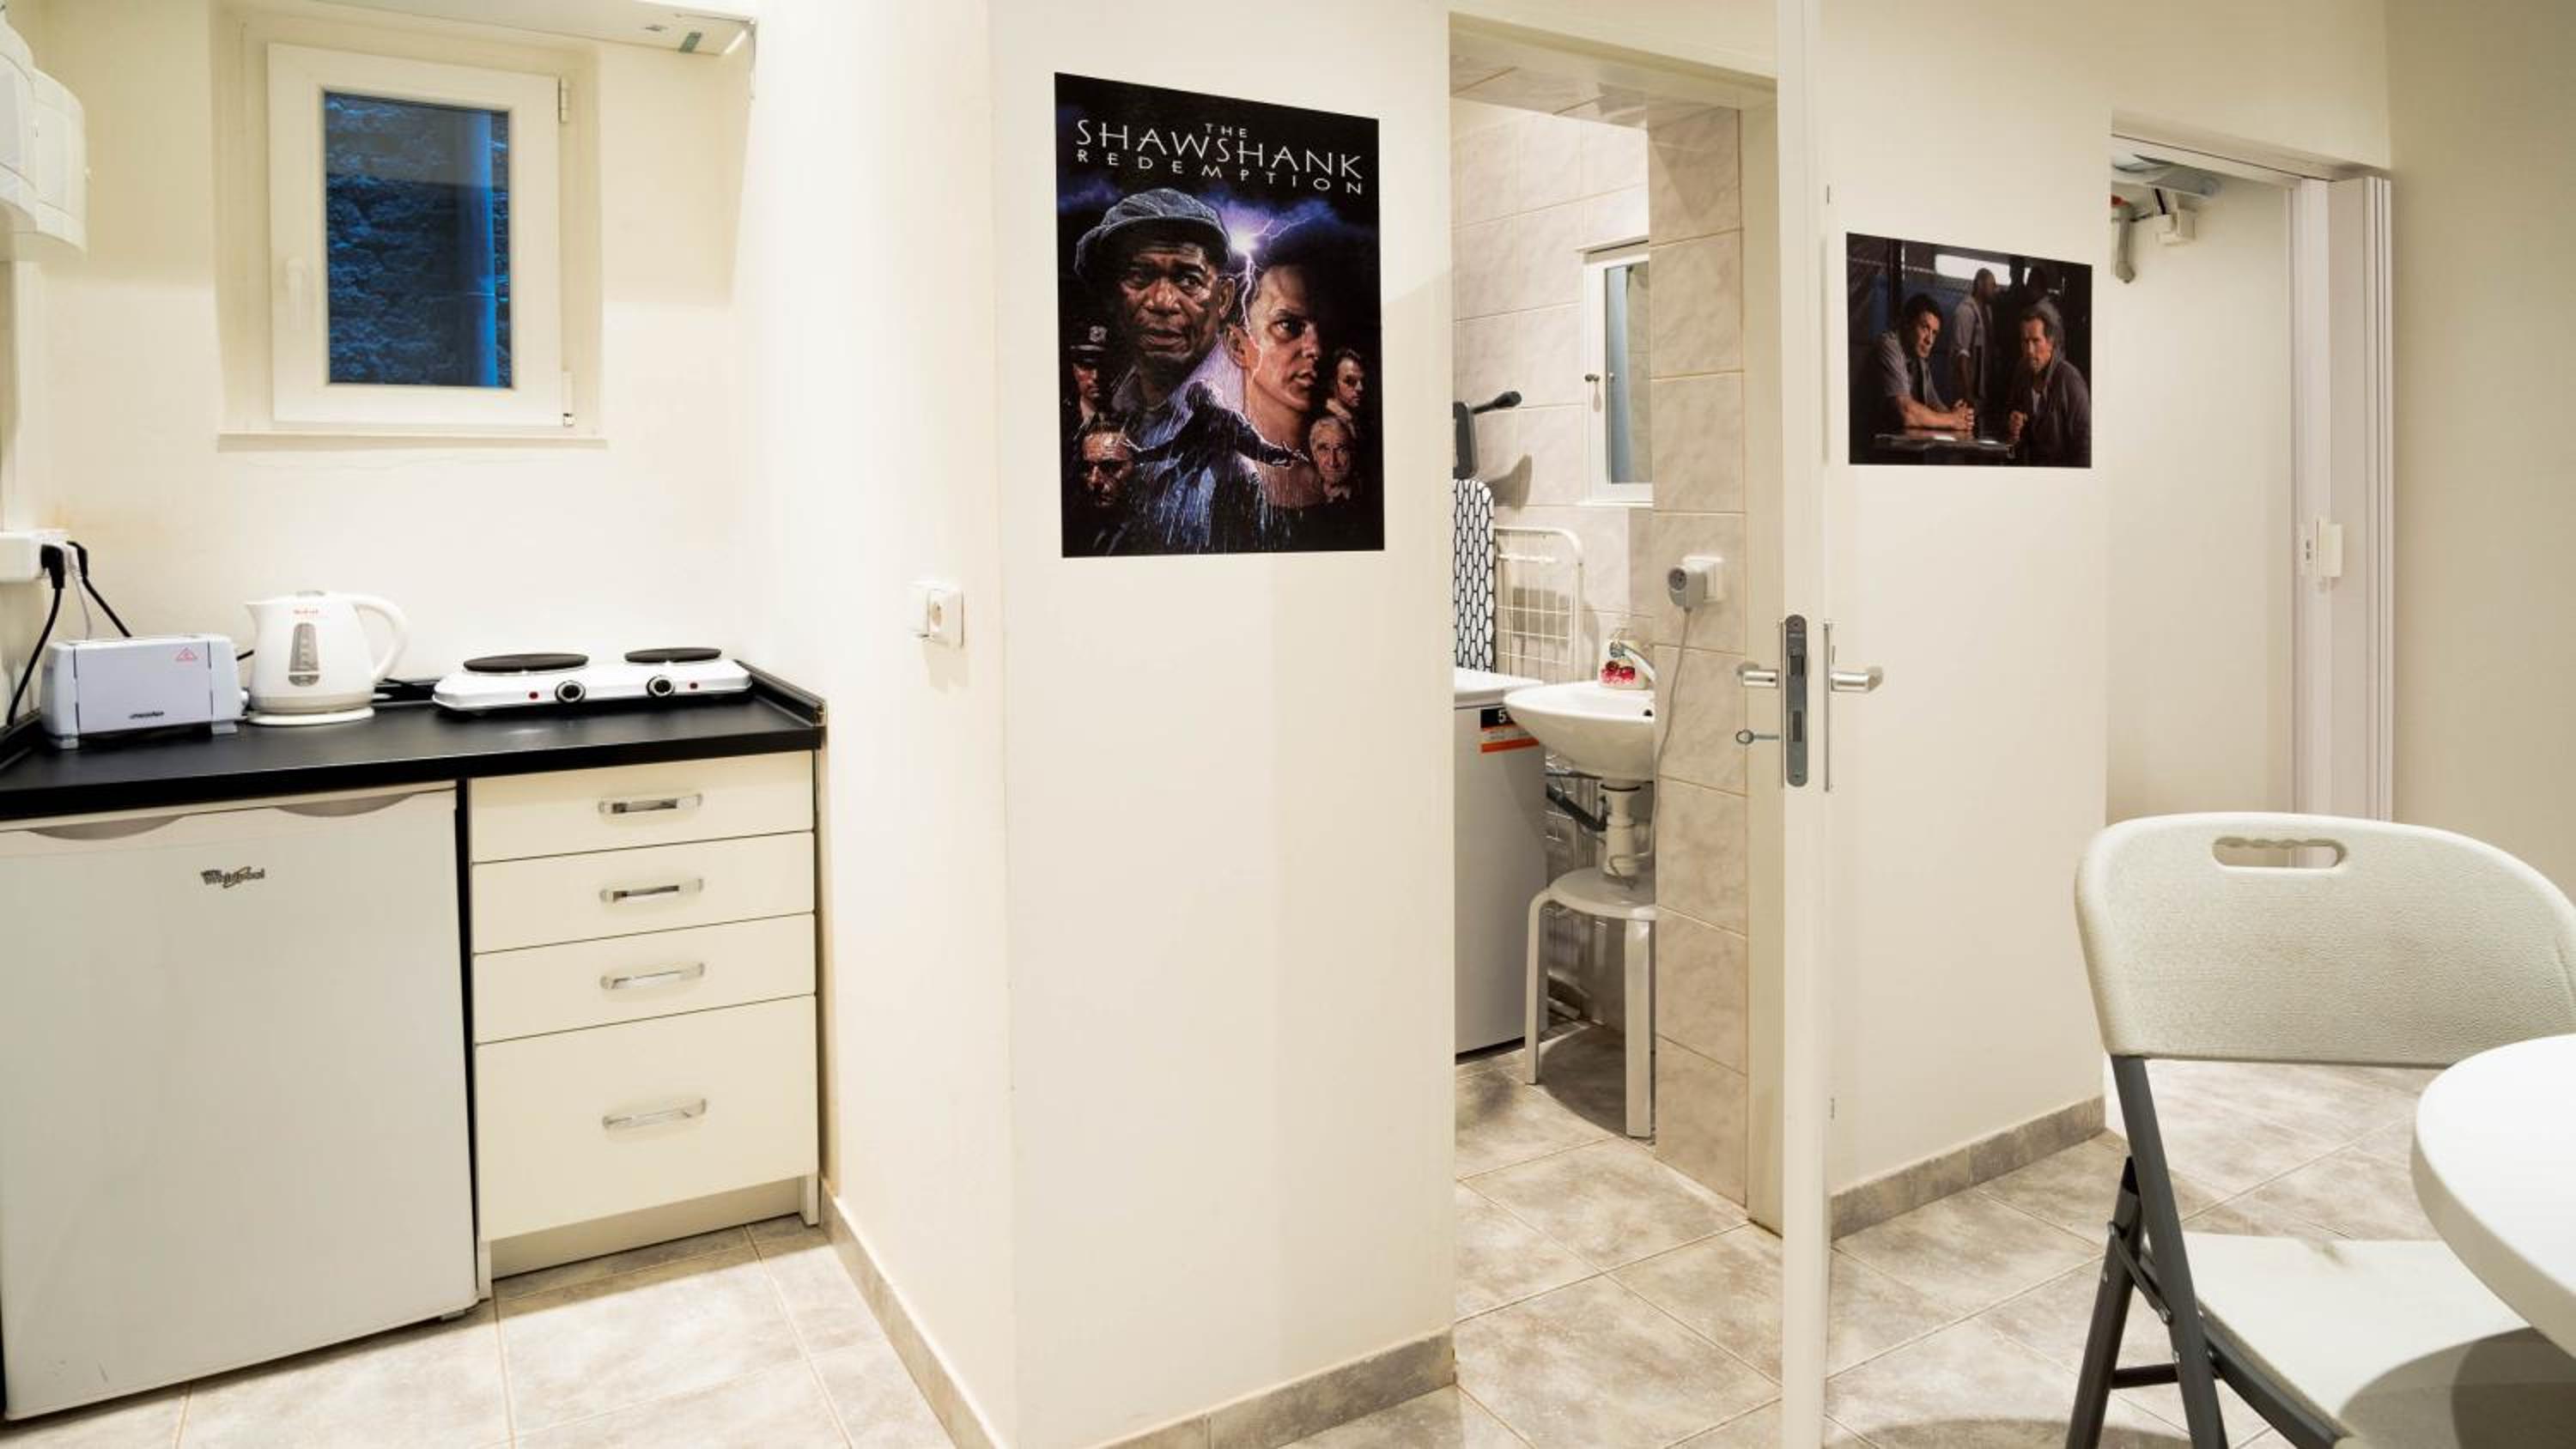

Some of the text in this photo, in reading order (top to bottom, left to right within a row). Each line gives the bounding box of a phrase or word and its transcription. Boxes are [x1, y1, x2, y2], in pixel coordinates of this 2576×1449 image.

[1076, 119, 1363, 179] SHAWSHANK
[1205, 123, 1248, 138] THE
[1077, 149, 1362, 195] REDEMPTION
